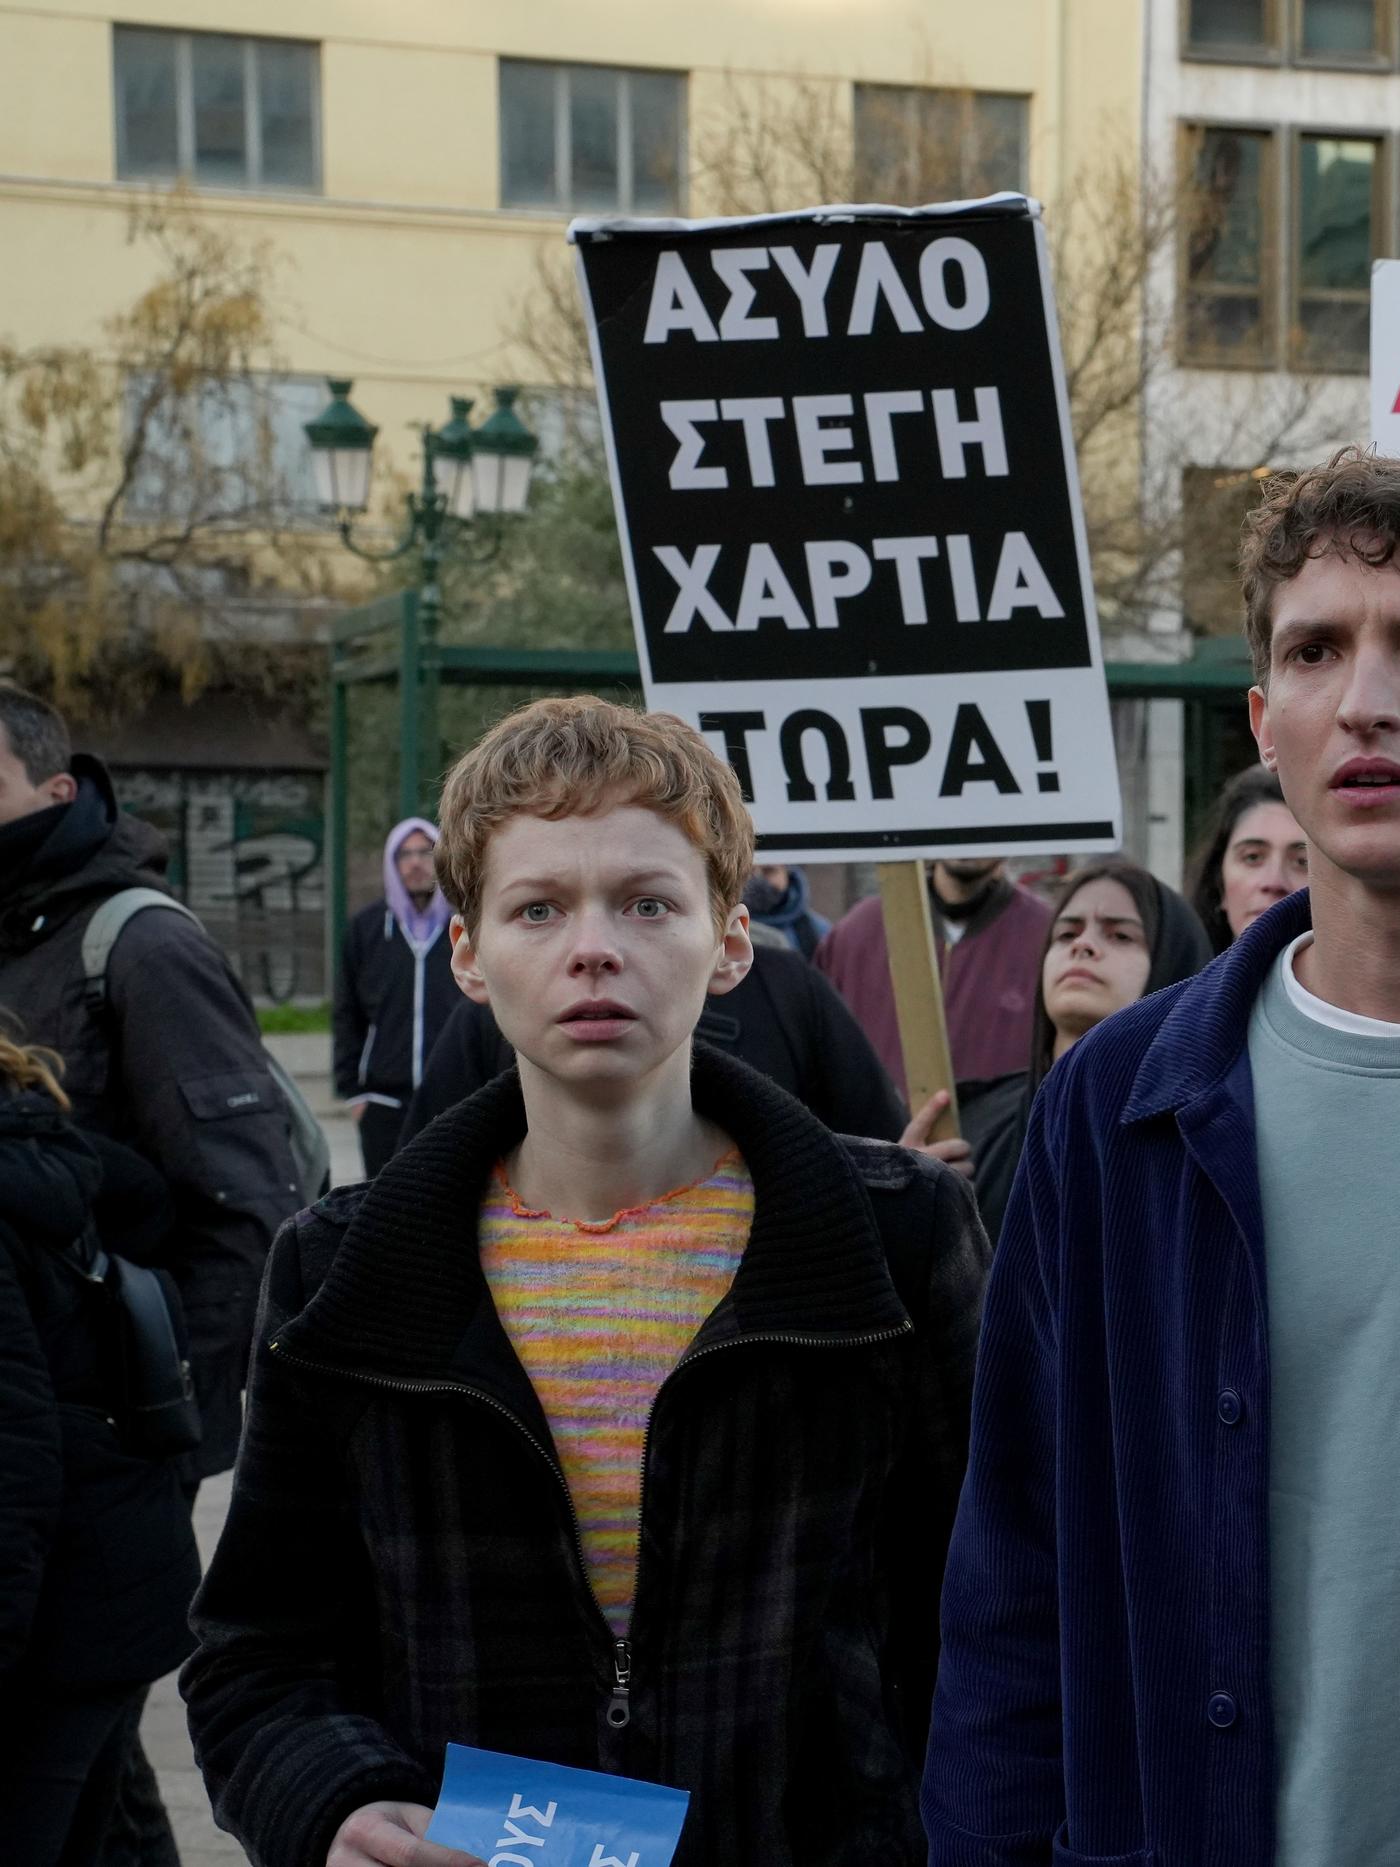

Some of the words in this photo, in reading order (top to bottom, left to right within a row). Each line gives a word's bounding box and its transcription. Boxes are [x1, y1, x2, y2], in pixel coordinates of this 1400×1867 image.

[643, 237, 990, 344] ΑΣΥΛΟ
[659, 386, 1009, 490] ΣΤΕΓΗ
[652, 531, 1065, 633] ΧΑΡΤΙΑ
[698, 699, 1061, 804] ΤΩΡΑ!
